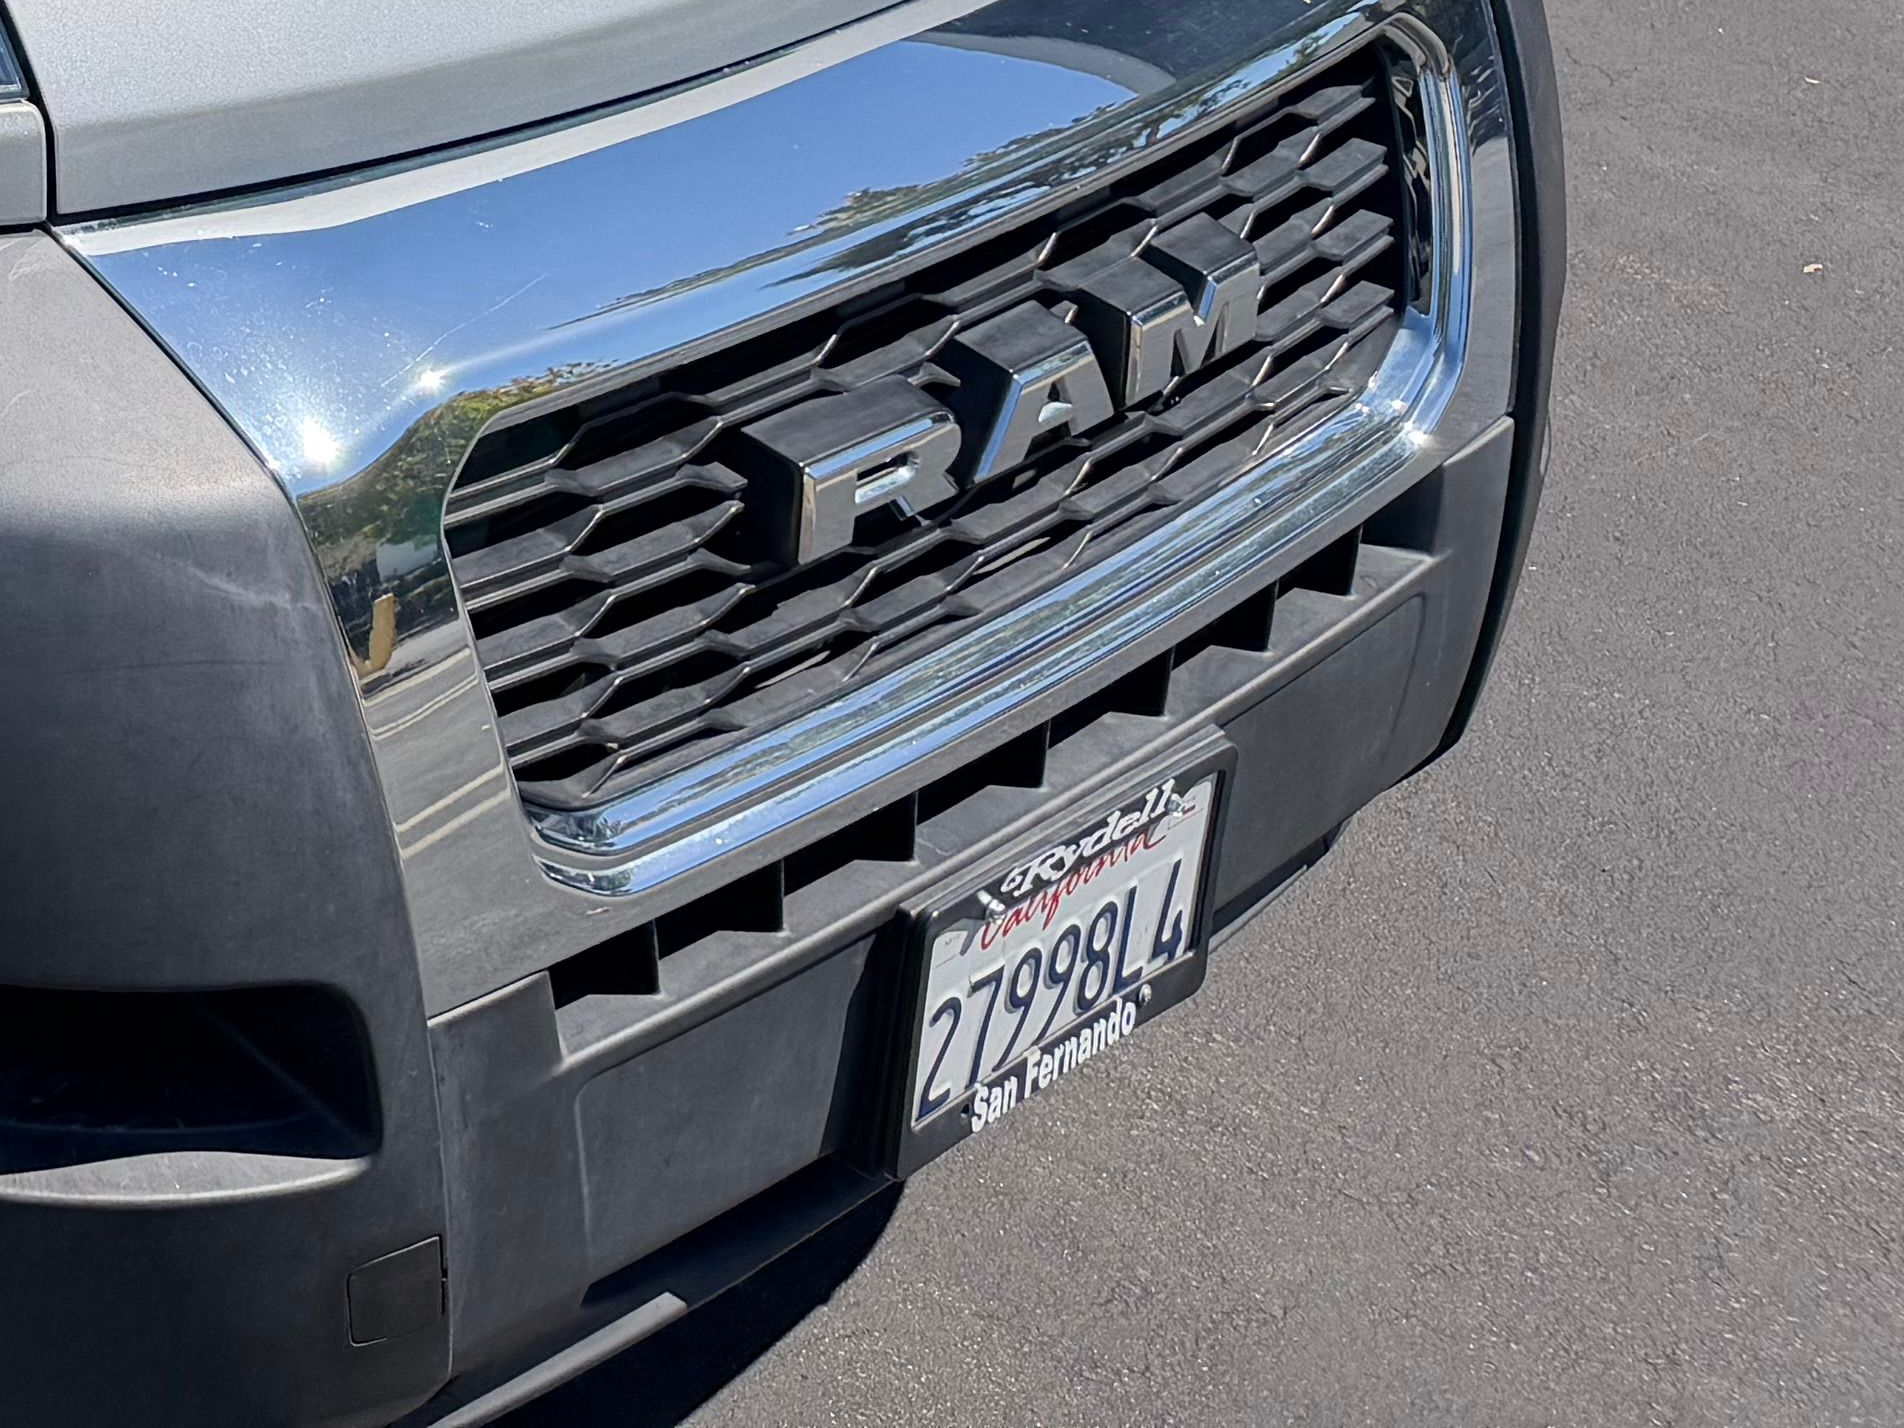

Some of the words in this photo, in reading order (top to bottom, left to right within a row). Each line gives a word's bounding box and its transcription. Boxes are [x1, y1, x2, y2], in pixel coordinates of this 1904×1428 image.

[792, 234, 1260, 566] RAM
[1000, 778, 1175, 896] Rydell
[915, 857, 1183, 1123] 27998L4
[971, 1082, 1018, 1133] San
[1024, 996, 1137, 1099] Fernando
